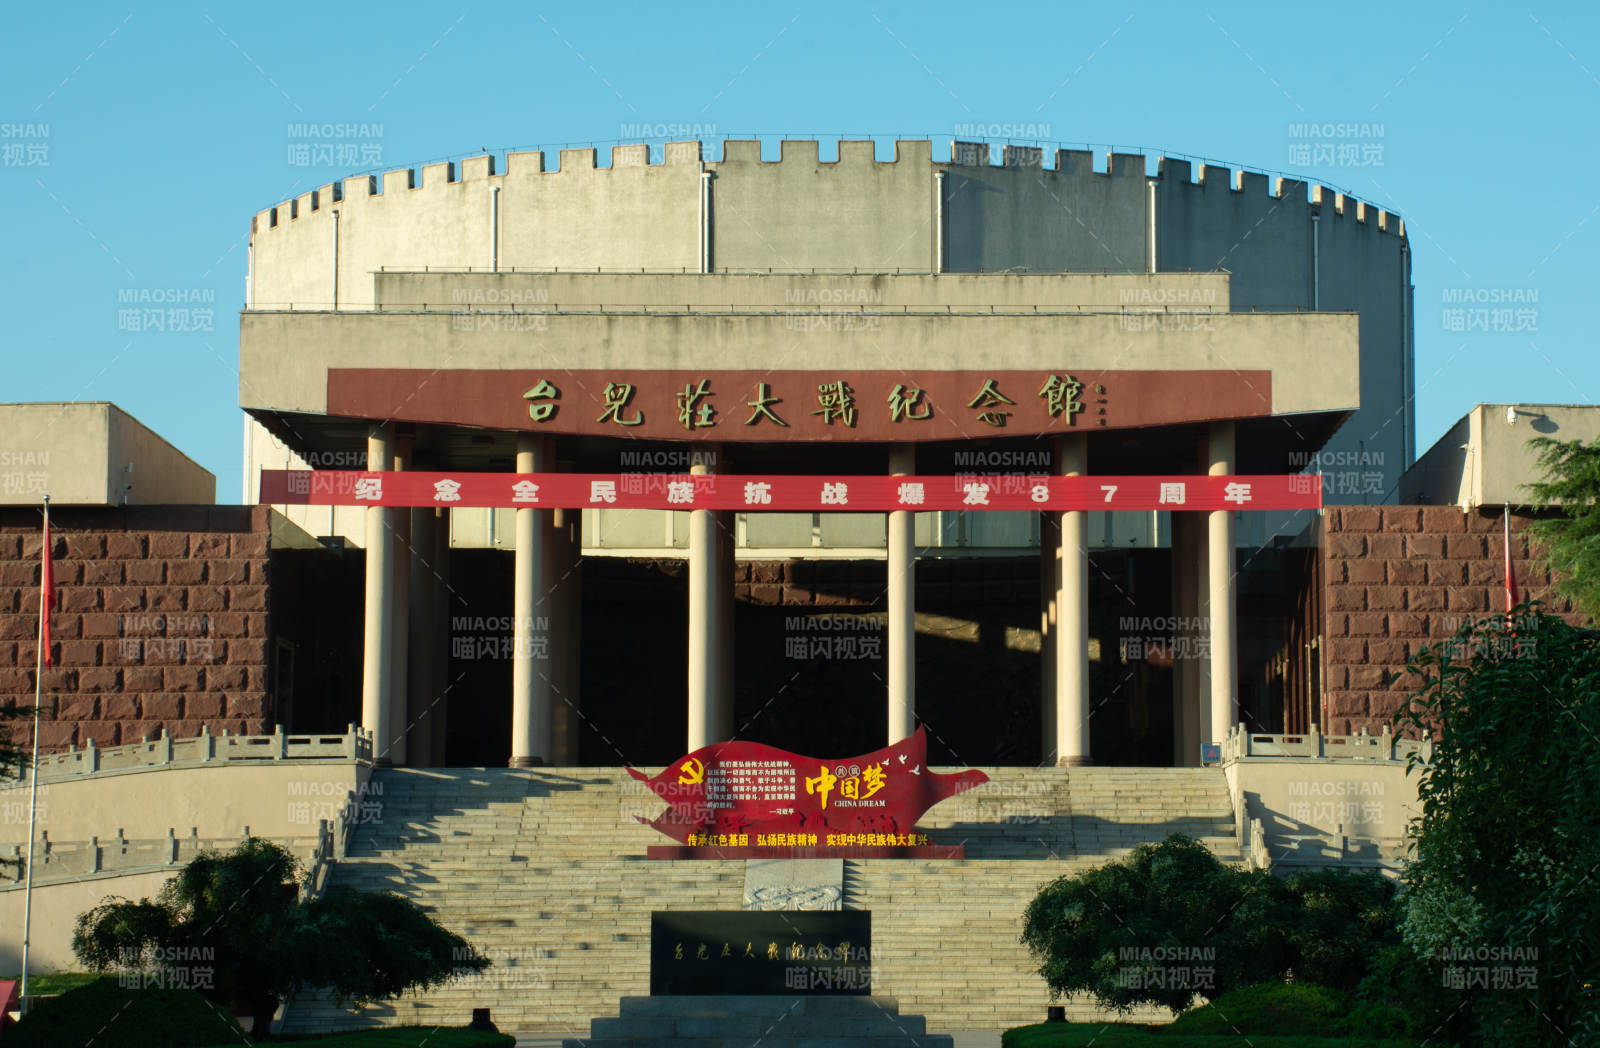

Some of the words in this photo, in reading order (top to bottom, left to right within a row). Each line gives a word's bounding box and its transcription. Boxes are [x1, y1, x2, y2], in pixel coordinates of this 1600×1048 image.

[355, 478, 1252, 505] 纪念全民族抗战爆发87周年
[806, 762, 887, 810] 中国梦
[687, 833, 748, 847] 传承红色基因
[757, 833, 818, 847] 弘扬民族精神
[826, 833, 928, 847] 实现中华民族伟大复兴
